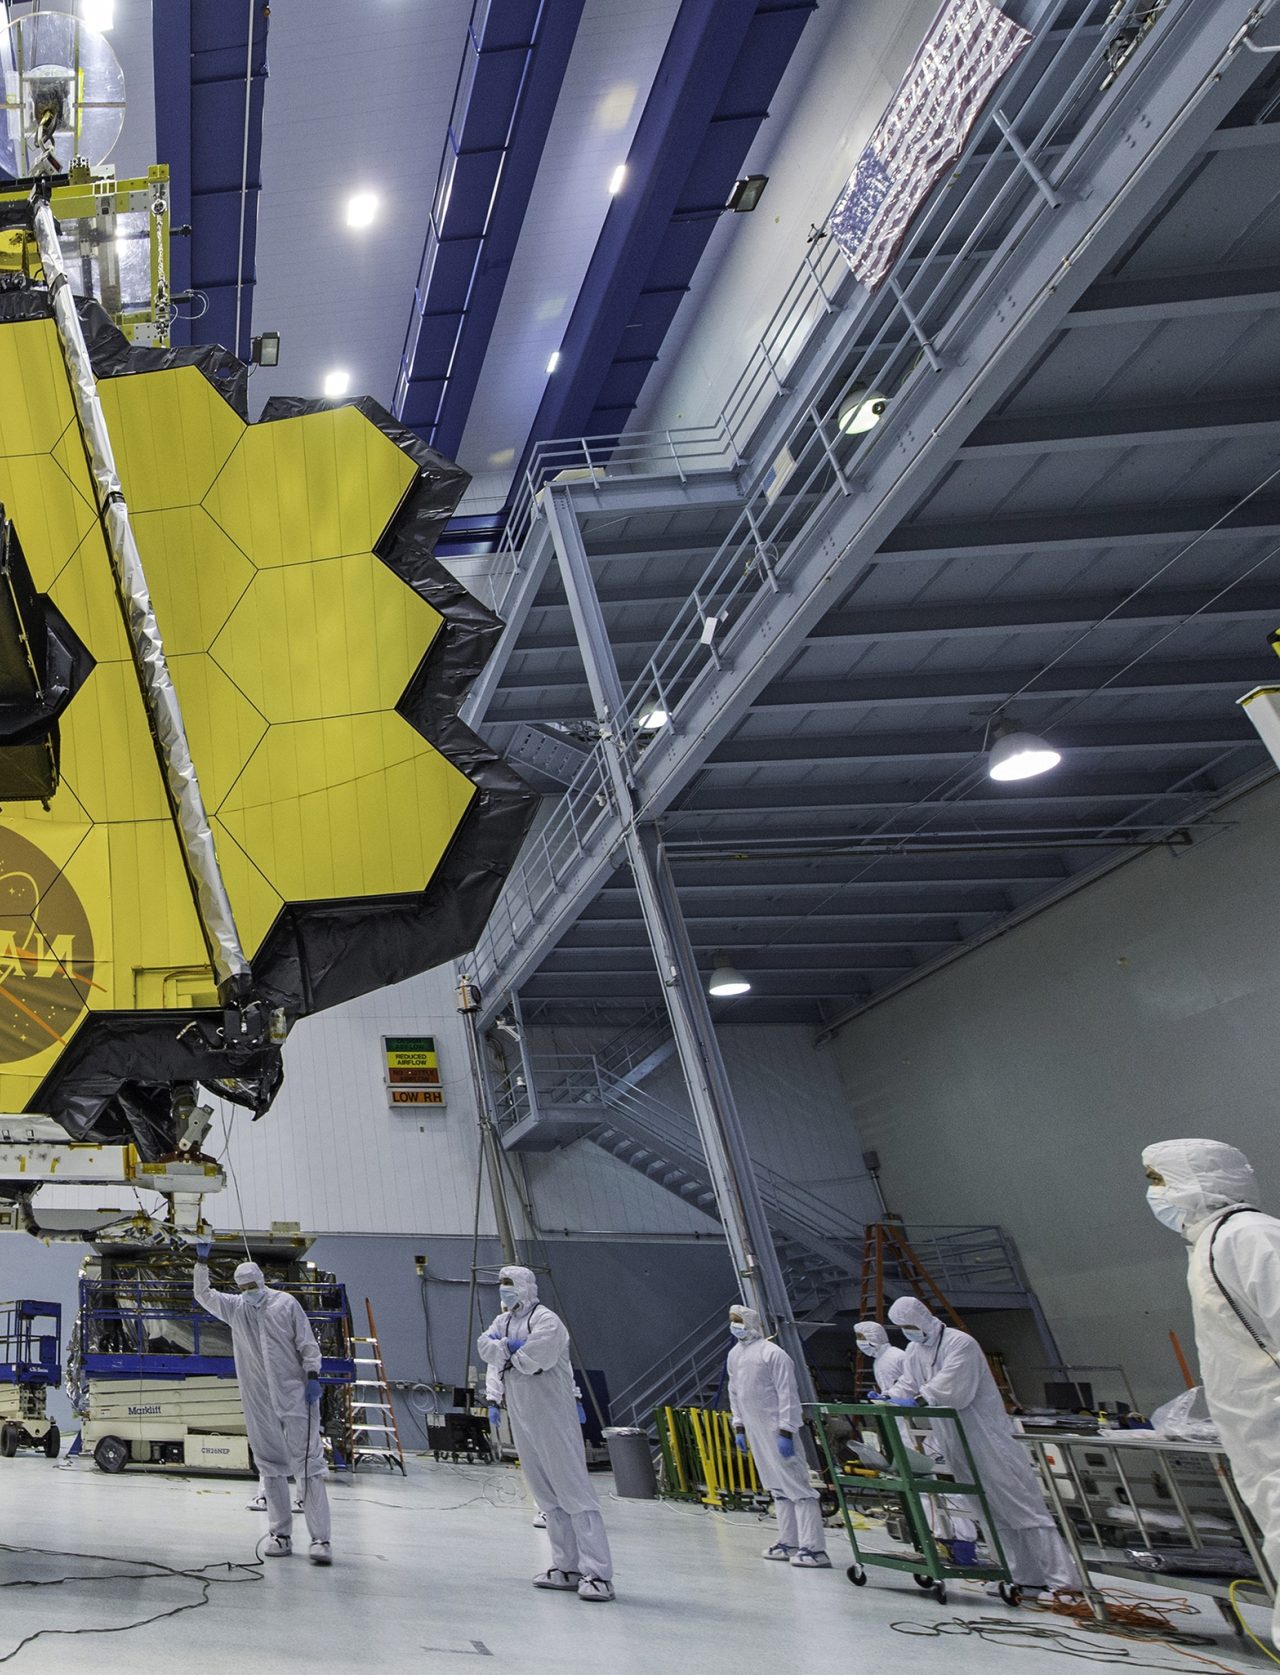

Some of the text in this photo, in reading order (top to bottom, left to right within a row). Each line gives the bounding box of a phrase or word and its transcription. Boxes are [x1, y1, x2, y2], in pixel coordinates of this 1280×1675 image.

[392, 1091, 443, 1102] LOW RH
[128, 1405, 161, 1415] Marklift
